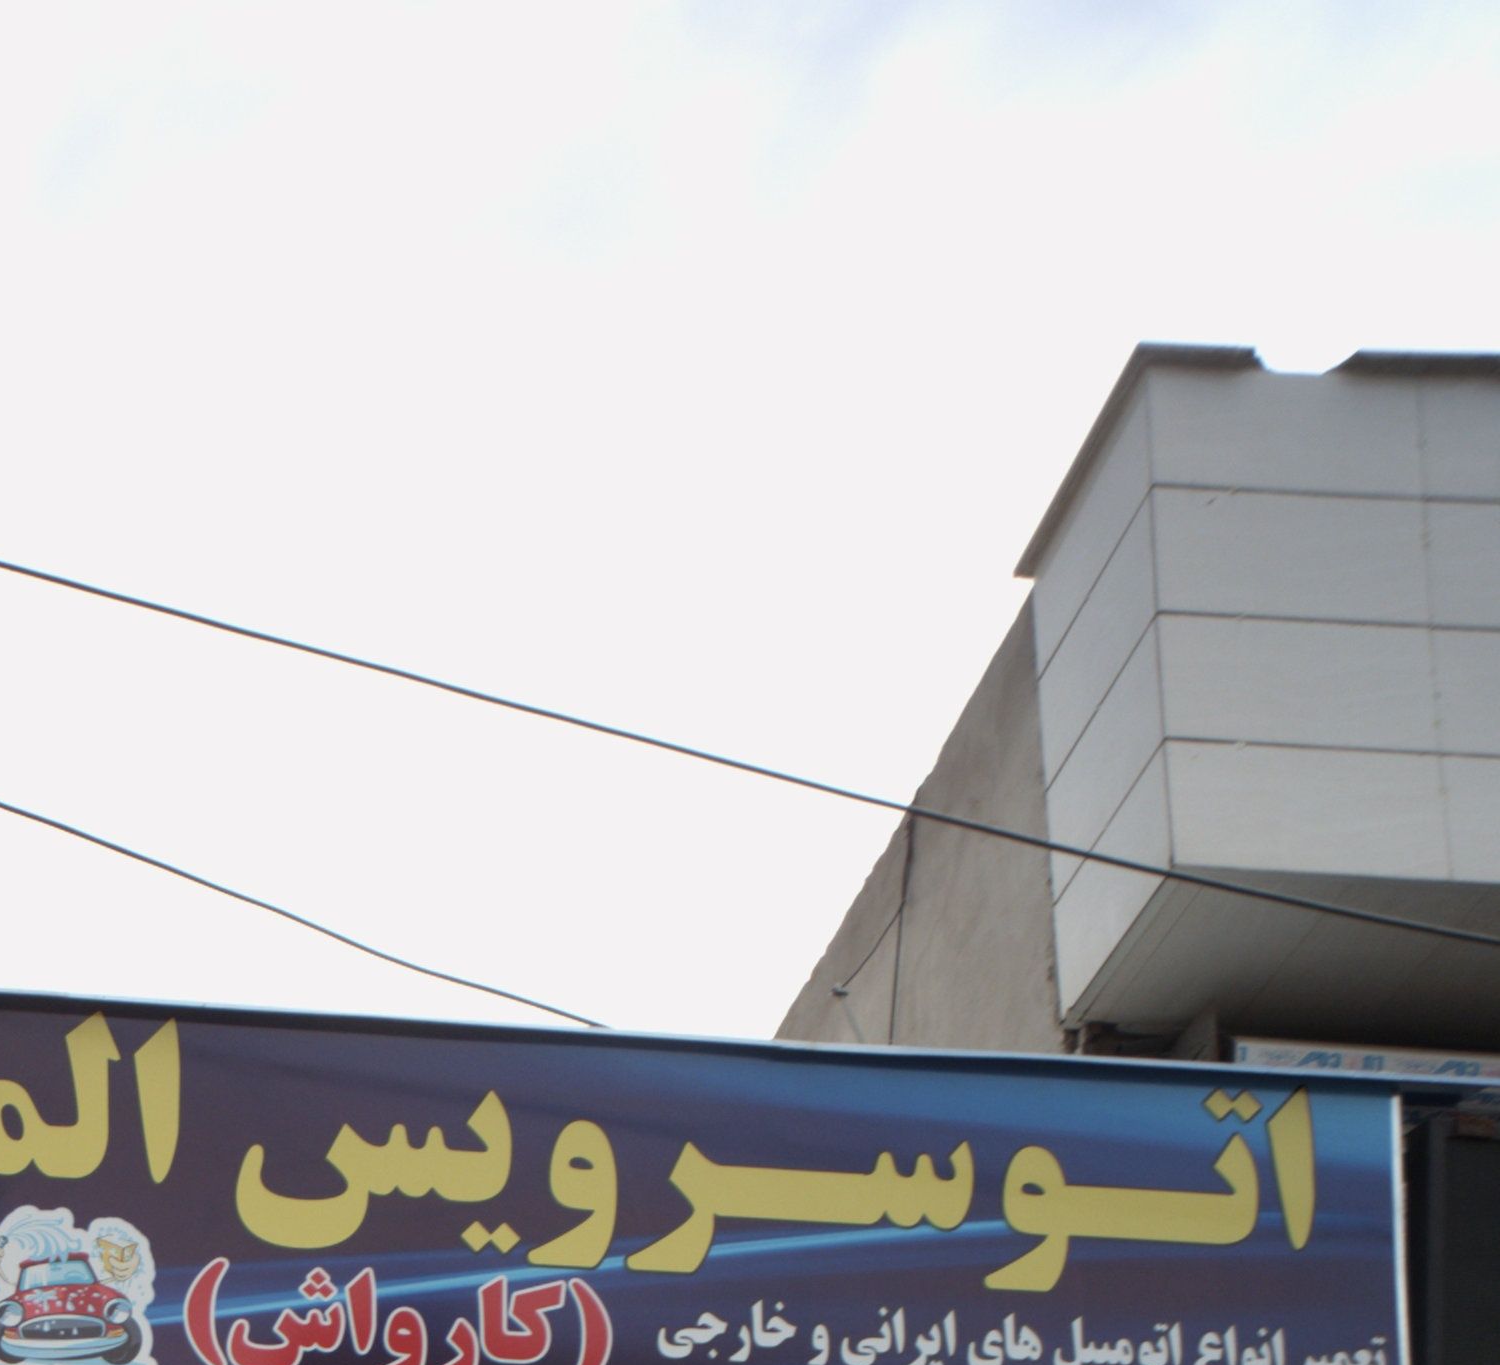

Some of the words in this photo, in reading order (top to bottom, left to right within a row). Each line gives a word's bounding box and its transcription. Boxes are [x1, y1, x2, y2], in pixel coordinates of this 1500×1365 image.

[236, 1089, 975, 1275] سرویس
[984, 1085, 1316, 1292] اتو
[656, 1299, 798, 1363] خارجی
